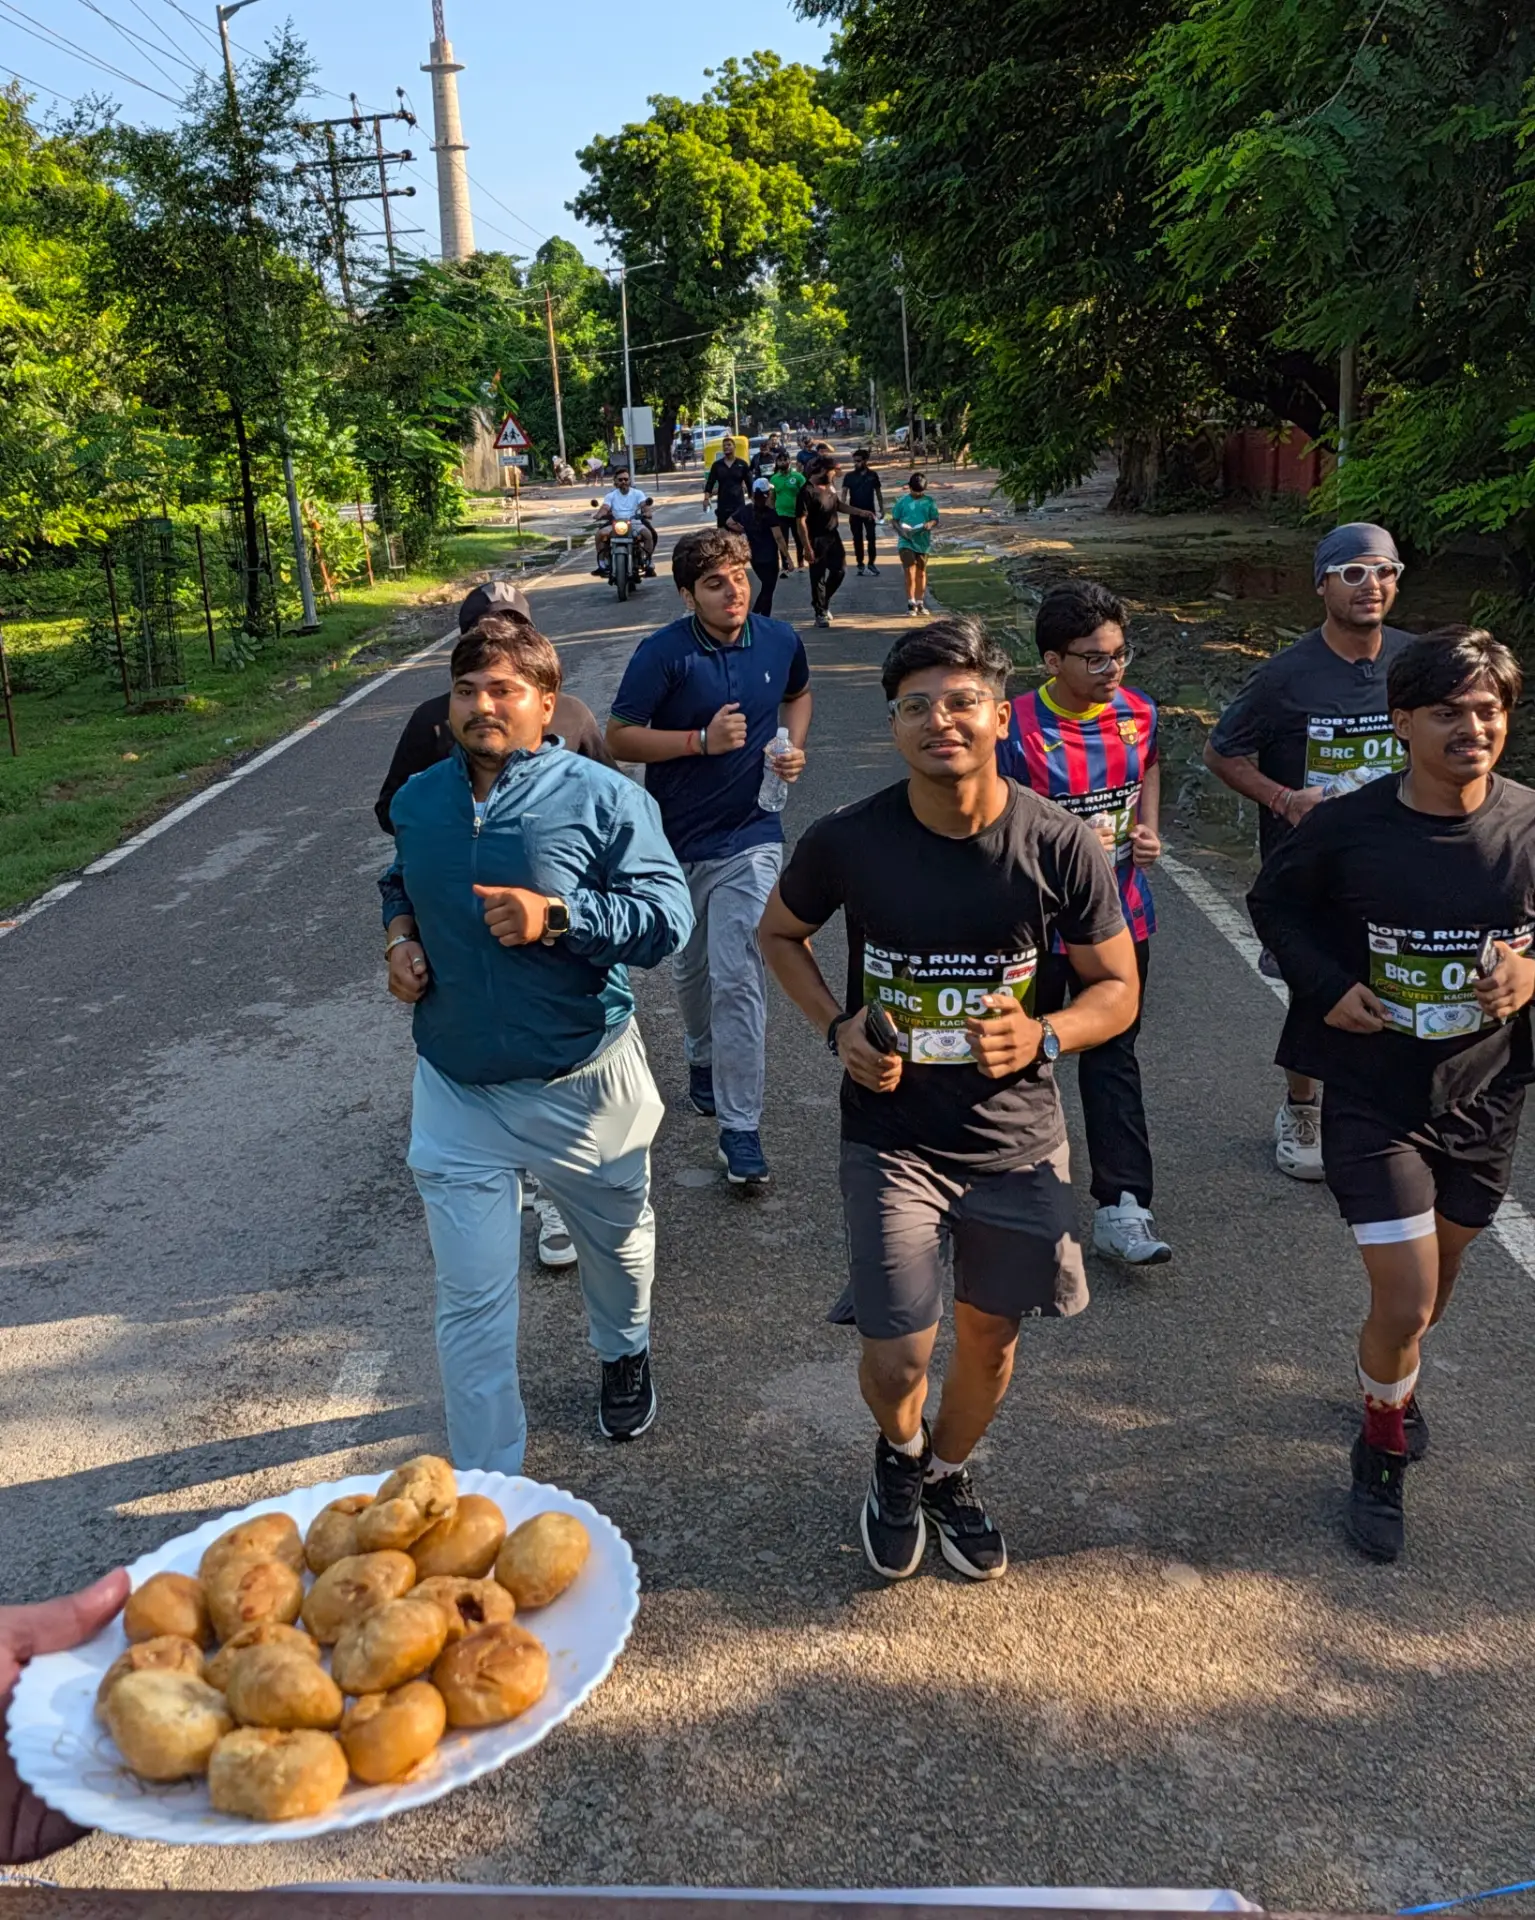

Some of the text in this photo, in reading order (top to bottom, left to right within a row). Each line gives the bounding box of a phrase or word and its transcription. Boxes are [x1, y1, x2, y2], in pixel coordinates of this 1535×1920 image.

[1310, 714, 1388, 726] BOB'S RUN
[1345, 724, 1396, 734] VARANAS
[1320, 747, 1355, 759] BRC
[1084, 792, 1113, 805] RUN
[1070, 799, 1122, 814] VARANASI
[1367, 921, 1426, 940] BOB'S
[1433, 930, 1480, 940] RUN
[865, 942, 1037, 965] BOB'S RUN CLUB
[1410, 943, 1479, 952] VARANA
[908, 967, 993, 977] VARANASI
[1385, 962, 1427, 987] BRC
[879, 986, 923, 1013] BRC
